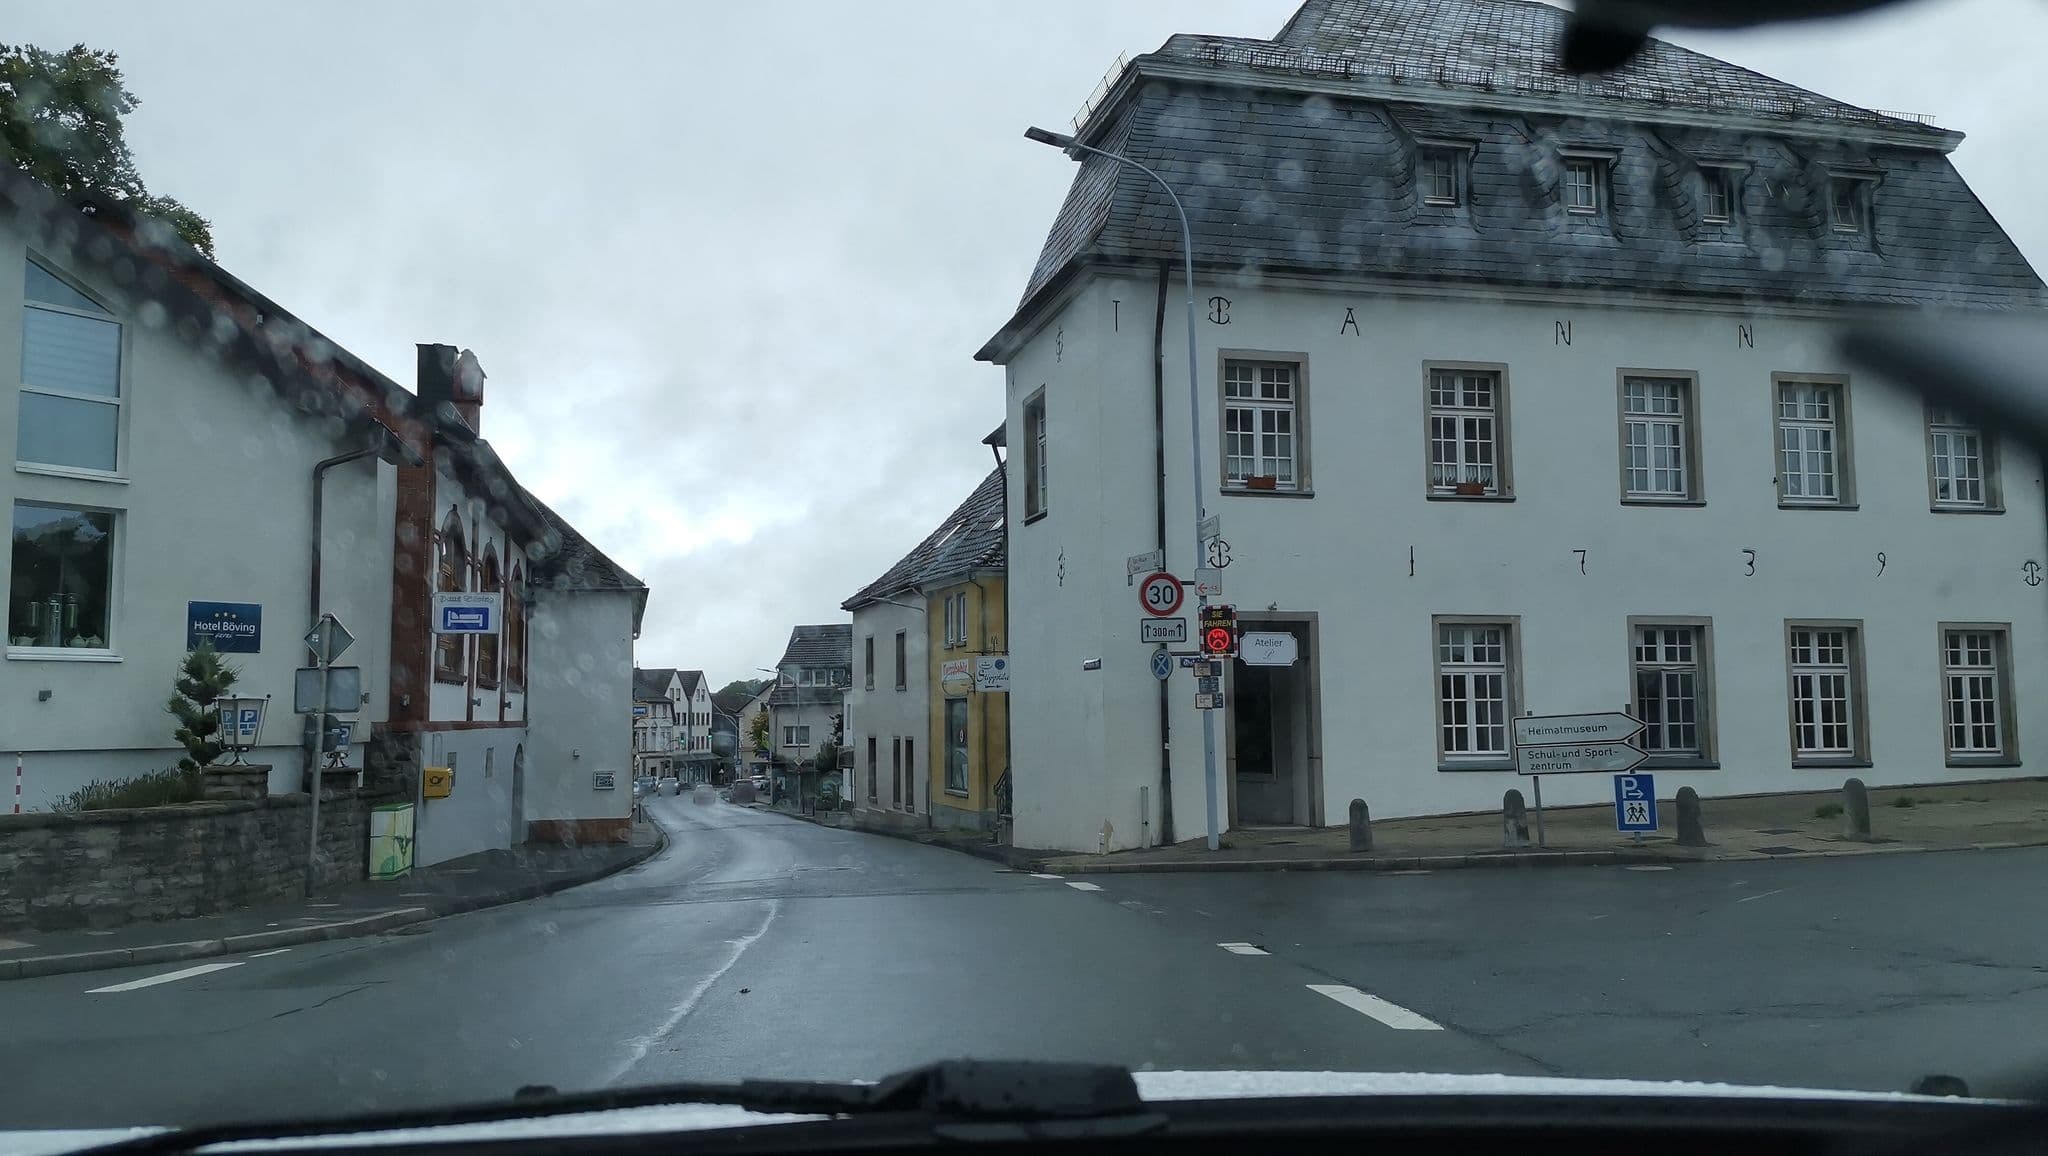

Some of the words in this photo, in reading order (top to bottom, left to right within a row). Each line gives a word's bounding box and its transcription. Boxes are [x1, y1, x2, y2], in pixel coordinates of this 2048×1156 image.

[1341, 307, 1359, 336] A
[1555, 321, 1571, 346] N
[1738, 325, 1753, 349] N
[1573, 550, 1586, 575] 7
[1742, 550, 1757, 577] 3
[1877, 553, 1886, 577] 9
[1149, 585, 1173, 604] 30
[194, 621, 221, 631] Hotel
[222, 622, 256, 634] Böving
[1204, 620, 1232, 628] FAHREN
[1254, 638, 1284, 647] Atelier
[1528, 724, 1608, 736] Heimatmuseum
[1584, 748, 1618, 758] Sport-
[1530, 762, 1572, 771] zentrum
[1621, 777, 1638, 799] P
